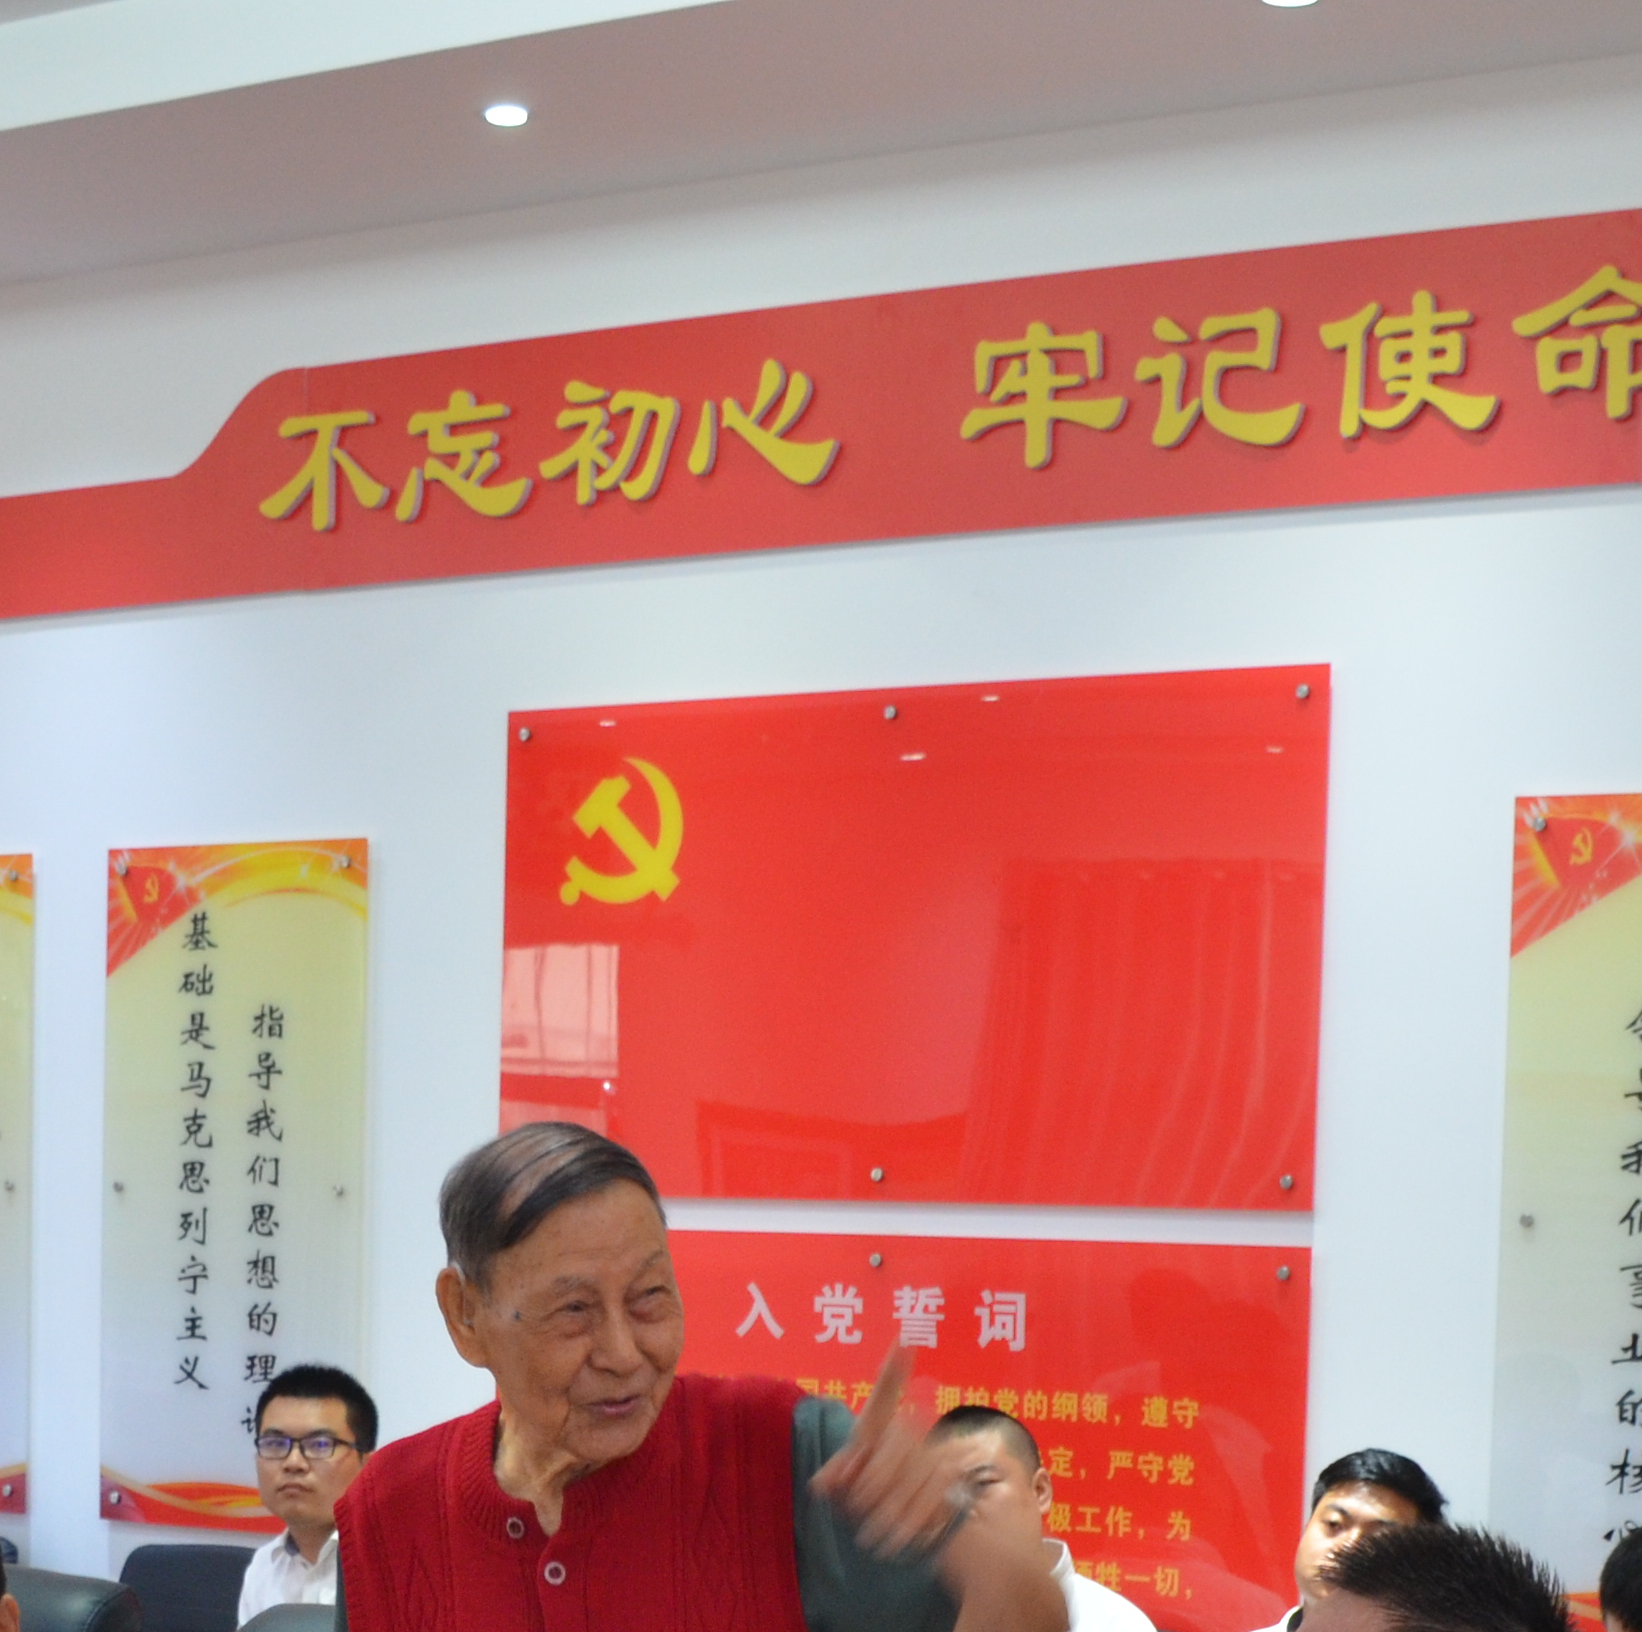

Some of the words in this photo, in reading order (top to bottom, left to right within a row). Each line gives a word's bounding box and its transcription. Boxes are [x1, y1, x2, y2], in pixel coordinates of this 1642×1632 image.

[259, 356, 840, 533] 不忘初心
[172, 911, 218, 1391] 基础是马克思列宁主义
[734, 1282, 1027, 1352] 入党誓词
